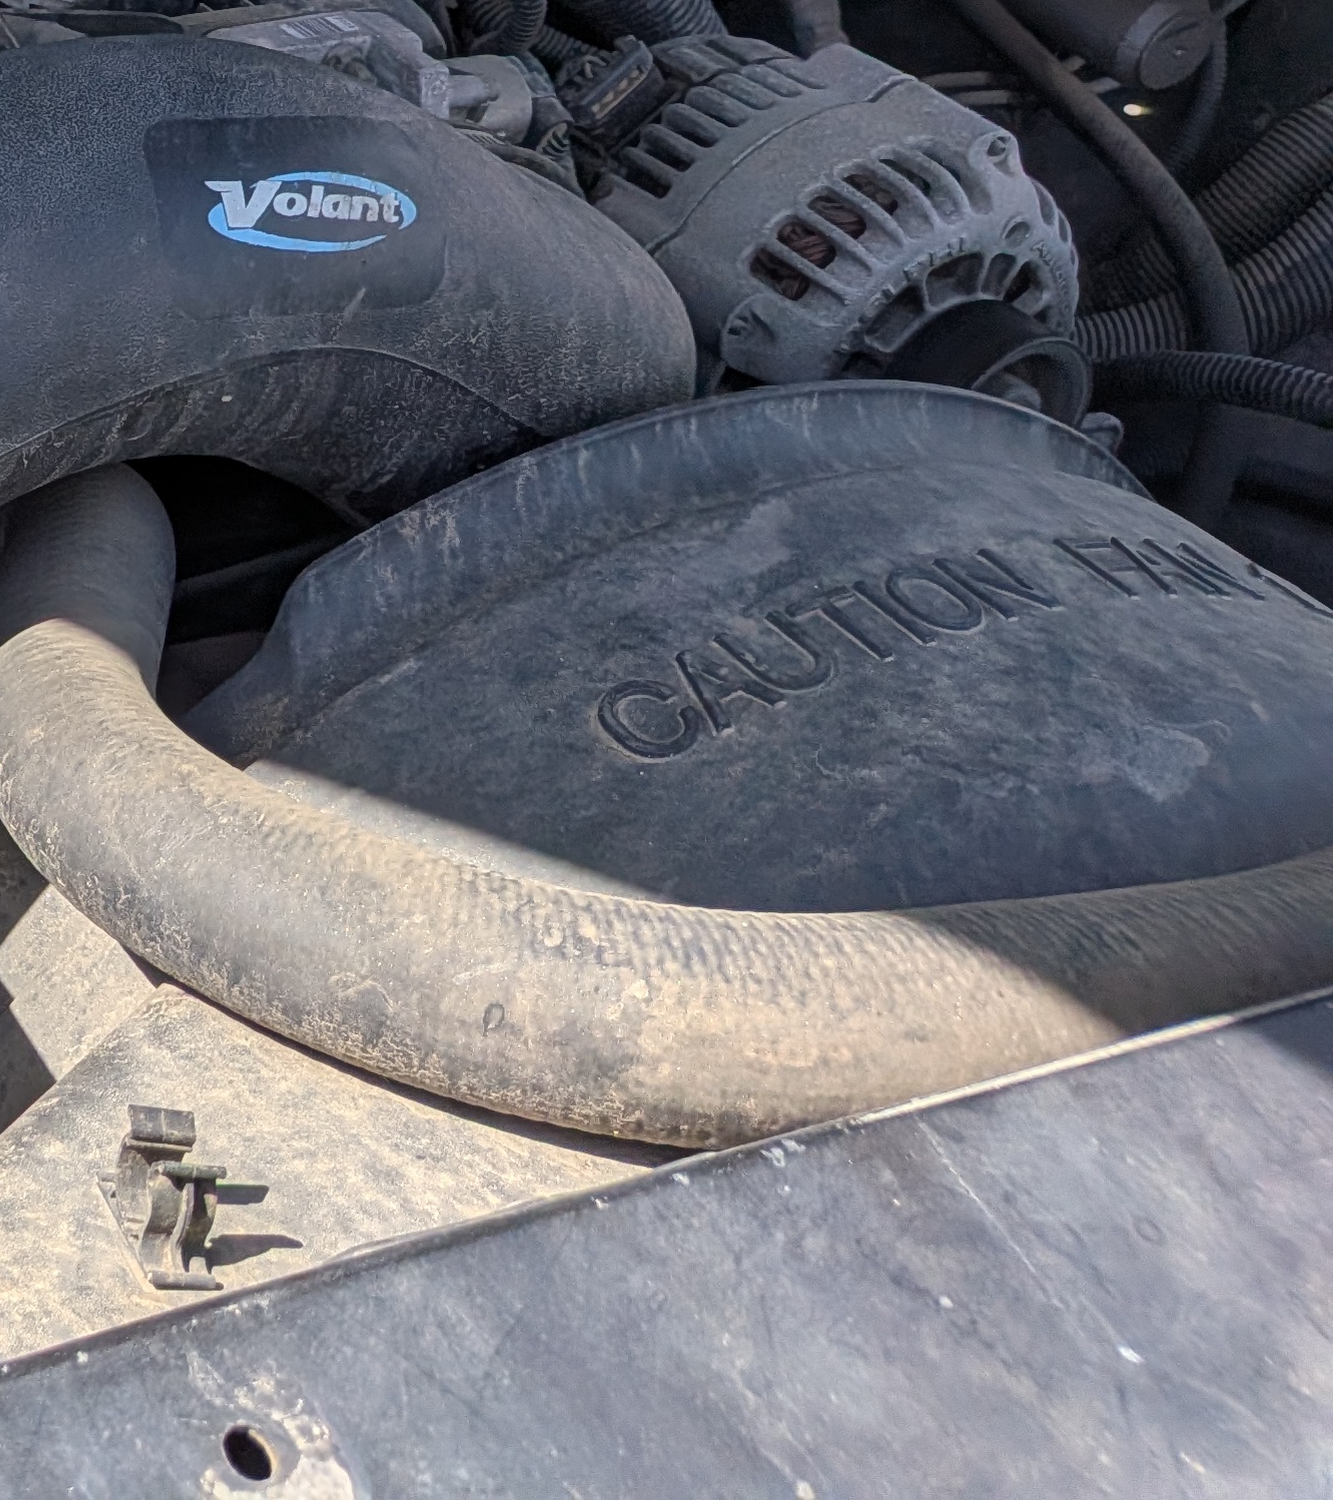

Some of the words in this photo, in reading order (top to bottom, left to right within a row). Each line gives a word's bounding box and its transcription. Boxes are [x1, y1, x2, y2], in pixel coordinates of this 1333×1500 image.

[204, 180, 400, 230] Volant
[593, 546, 1065, 762] CAUTION
[1053, 536, 1265, 602] FAN
